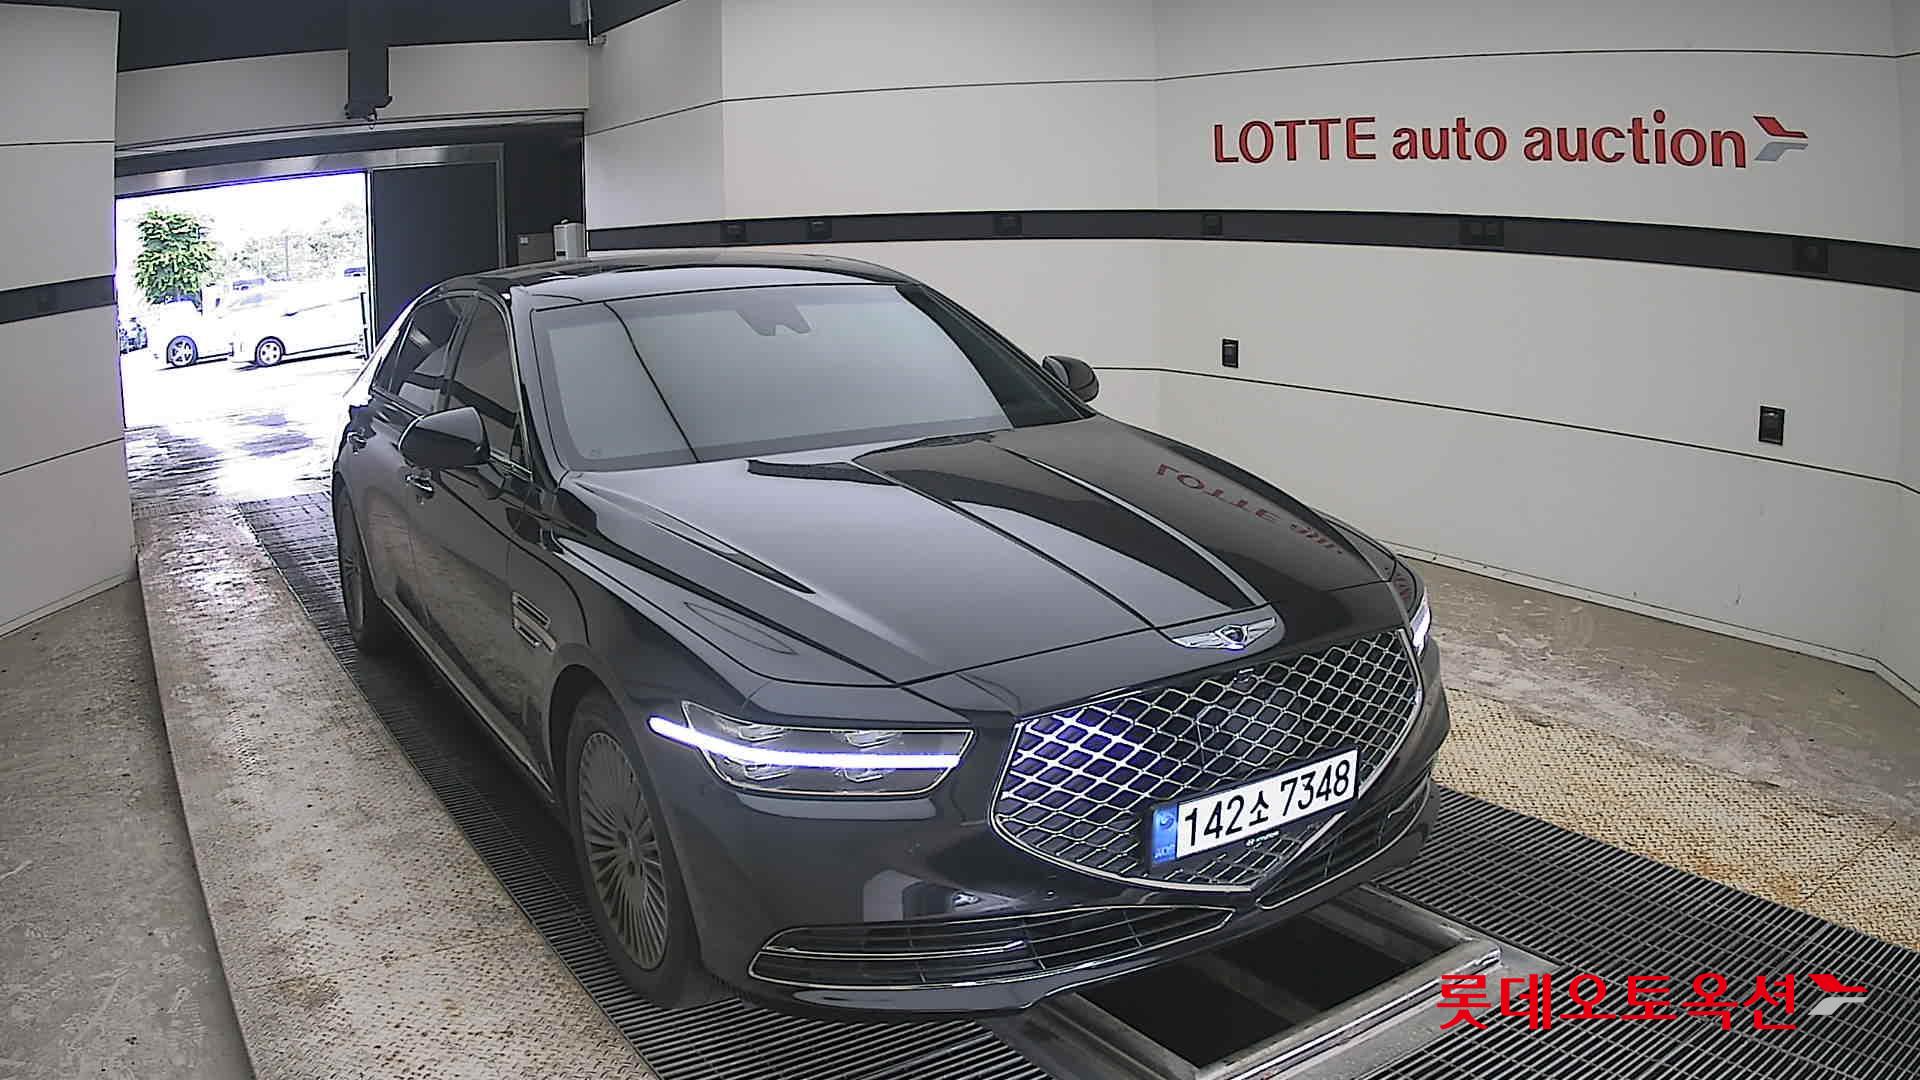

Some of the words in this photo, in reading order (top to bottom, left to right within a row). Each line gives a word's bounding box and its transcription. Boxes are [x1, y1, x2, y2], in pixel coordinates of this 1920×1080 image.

[1213, 116, 1377, 163] LOTTE
[1391, 117, 1509, 162] auto
[1523, 109, 1748, 169] auction
[1280, 759, 1350, 817] 7348
